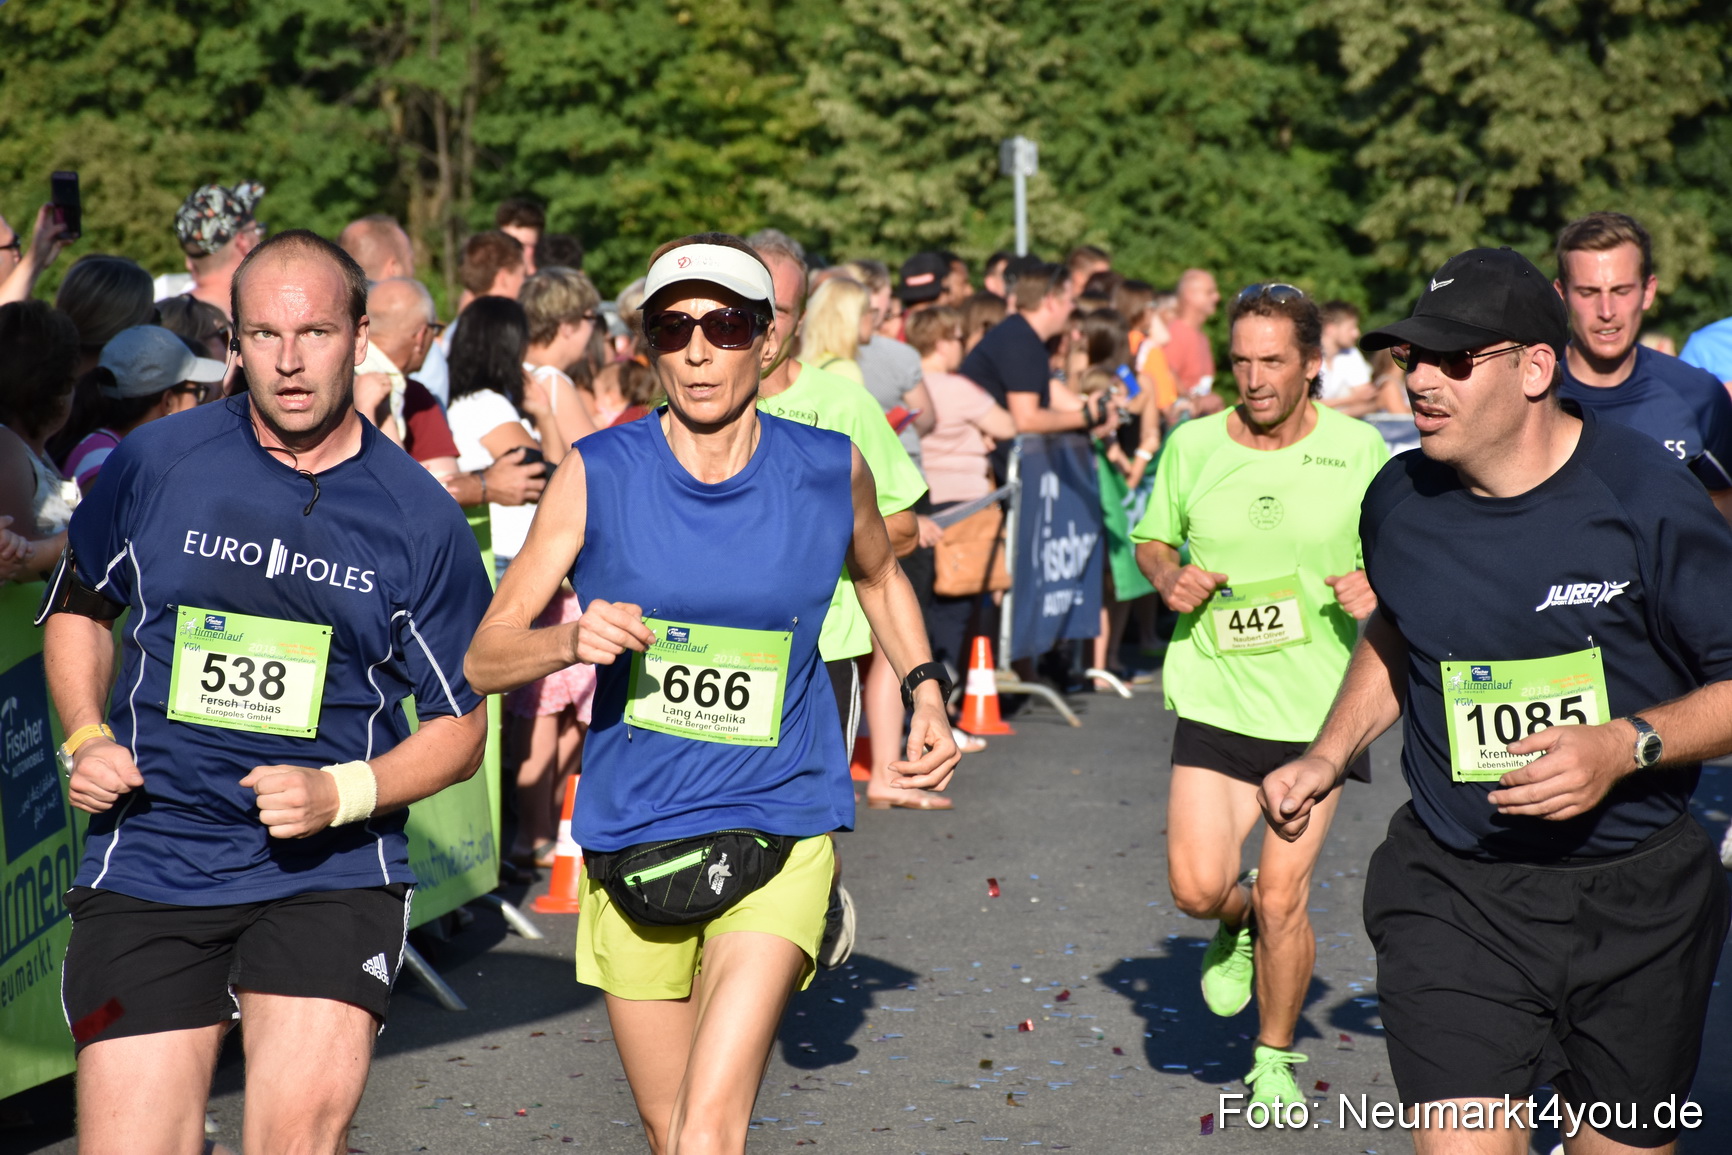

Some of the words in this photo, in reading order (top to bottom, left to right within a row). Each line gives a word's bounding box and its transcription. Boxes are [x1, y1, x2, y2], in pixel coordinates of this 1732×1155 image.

[1316, 457, 1347, 468] DEKRA
[183, 530, 263, 566] EURO
[290, 552, 375, 593] POLES
[1535, 583, 1603, 612] JURA
[1229, 605, 1283, 634] 442
[193, 627, 245, 643] firmenlauf
[1263, 631, 1285, 639] Oliver
[249, 642, 277, 654] 2018
[655, 638, 709, 654] firmenlauf
[712, 654, 741, 665] 2018
[201, 653, 287, 701] 538
[1463, 679, 1512, 690] firmenlauf
[663, 665, 751, 711] 666
[1521, 685, 1551, 697] 2018
[200, 694, 238, 709] Fersch
[243, 700, 281, 714] Tobias
[206, 707, 245, 719] Europoles
[247, 713, 272, 722] GmbH
[662, 704, 691, 719] Lang
[694, 711, 746, 724] Angelika
[1467, 695, 1587, 746] 1085
[665, 716, 683, 726] Fritz
[685, 720, 712, 732] Berger
[714, 724, 739, 733] GmbH
[5, 718, 43, 763] Fischer
[11, 748, 45, 779] AUTOMOBILE
[1477, 760, 1524, 769] Lebenshilfe
[362, 962, 390, 986] adidas
